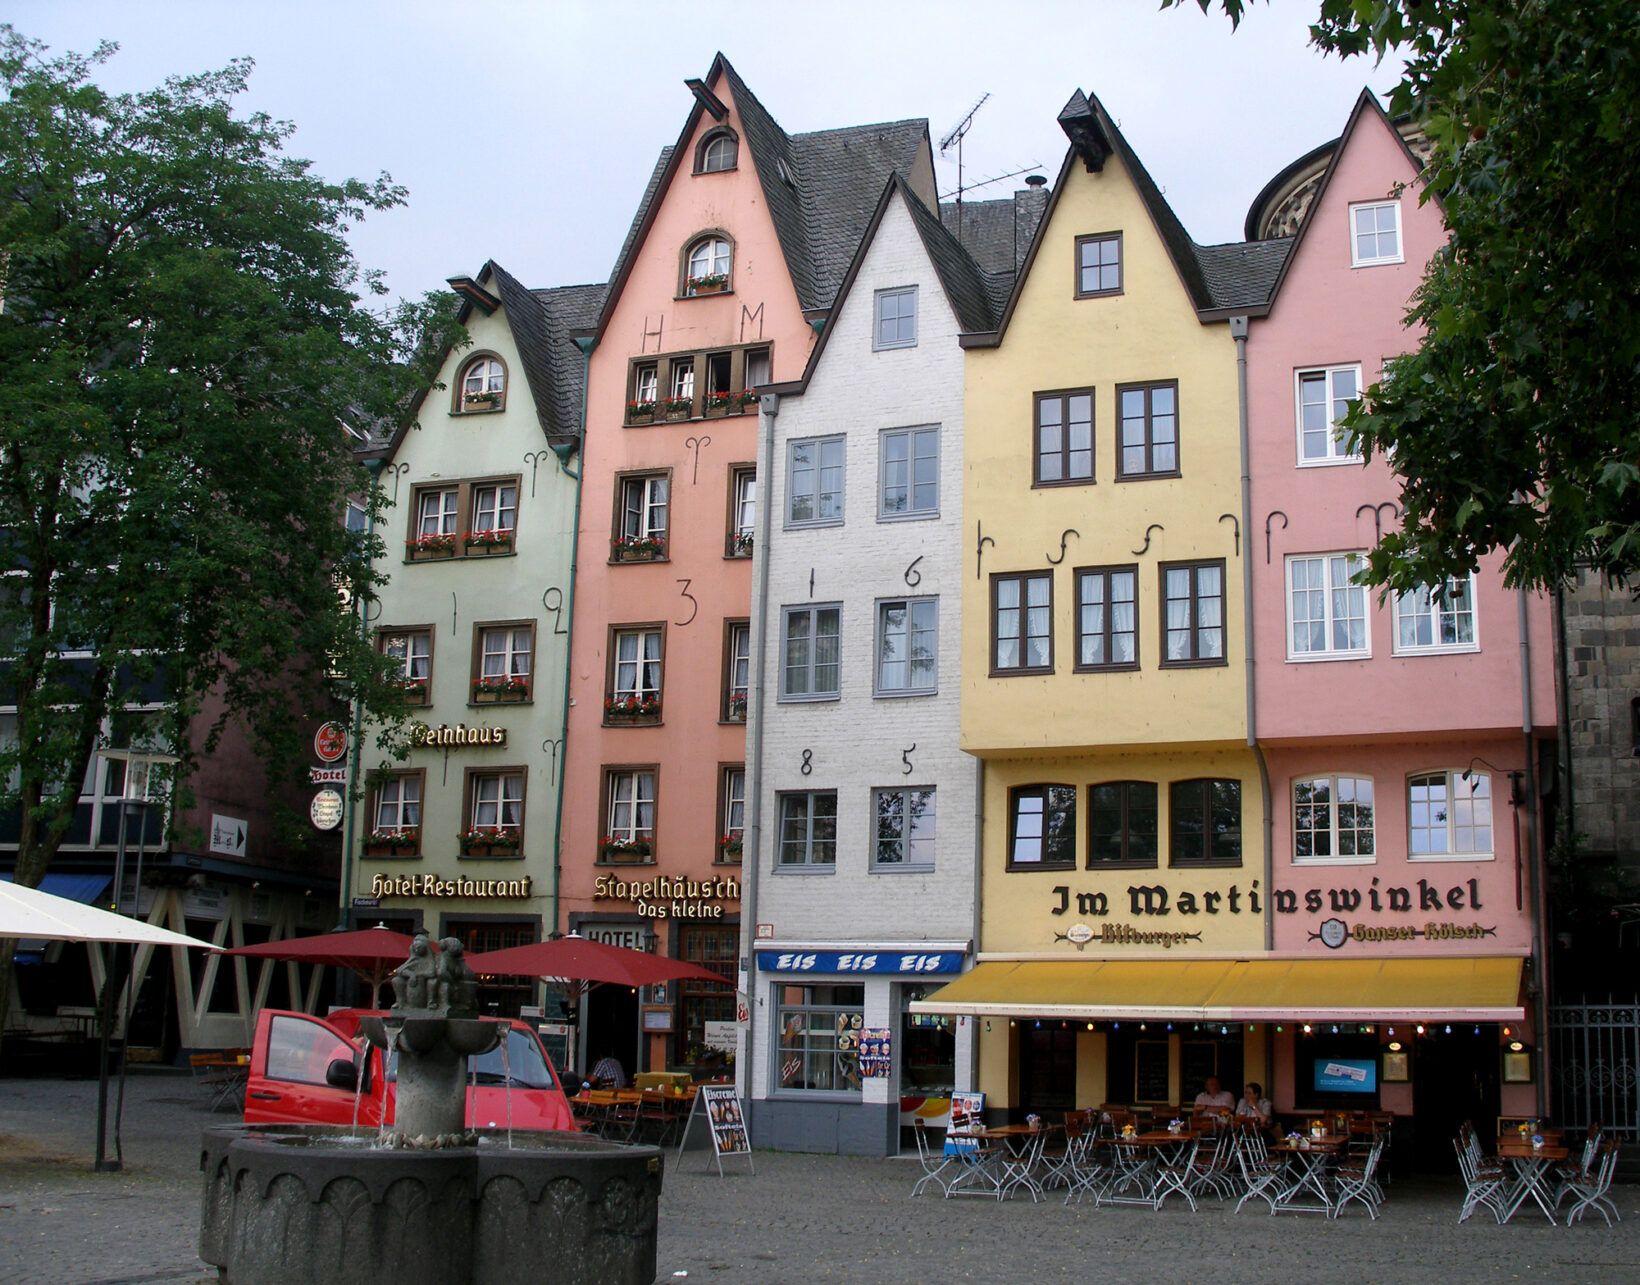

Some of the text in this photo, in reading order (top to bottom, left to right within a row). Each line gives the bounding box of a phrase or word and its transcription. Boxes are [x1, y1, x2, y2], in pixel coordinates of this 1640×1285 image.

[904, 555, 924, 587] 6
[673, 578, 698, 627] 3
[800, 742, 917, 776] 8 5
[371, 873, 530, 898] Hotel-Restaurant
[1127, 876, 1483, 916] Martinswinkel
[637, 899, 723, 919] das kleine
[1101, 922, 1189, 949] Bitburger
[1352, 923, 1416, 942] Ganser
[1423, 921, 1486, 940] Kölsch
[776, 954, 817, 971] EIS
[836, 954, 878, 971] EIS
[899, 954, 942, 972] EIS
[706, 1089, 737, 1100] Eiscreme
